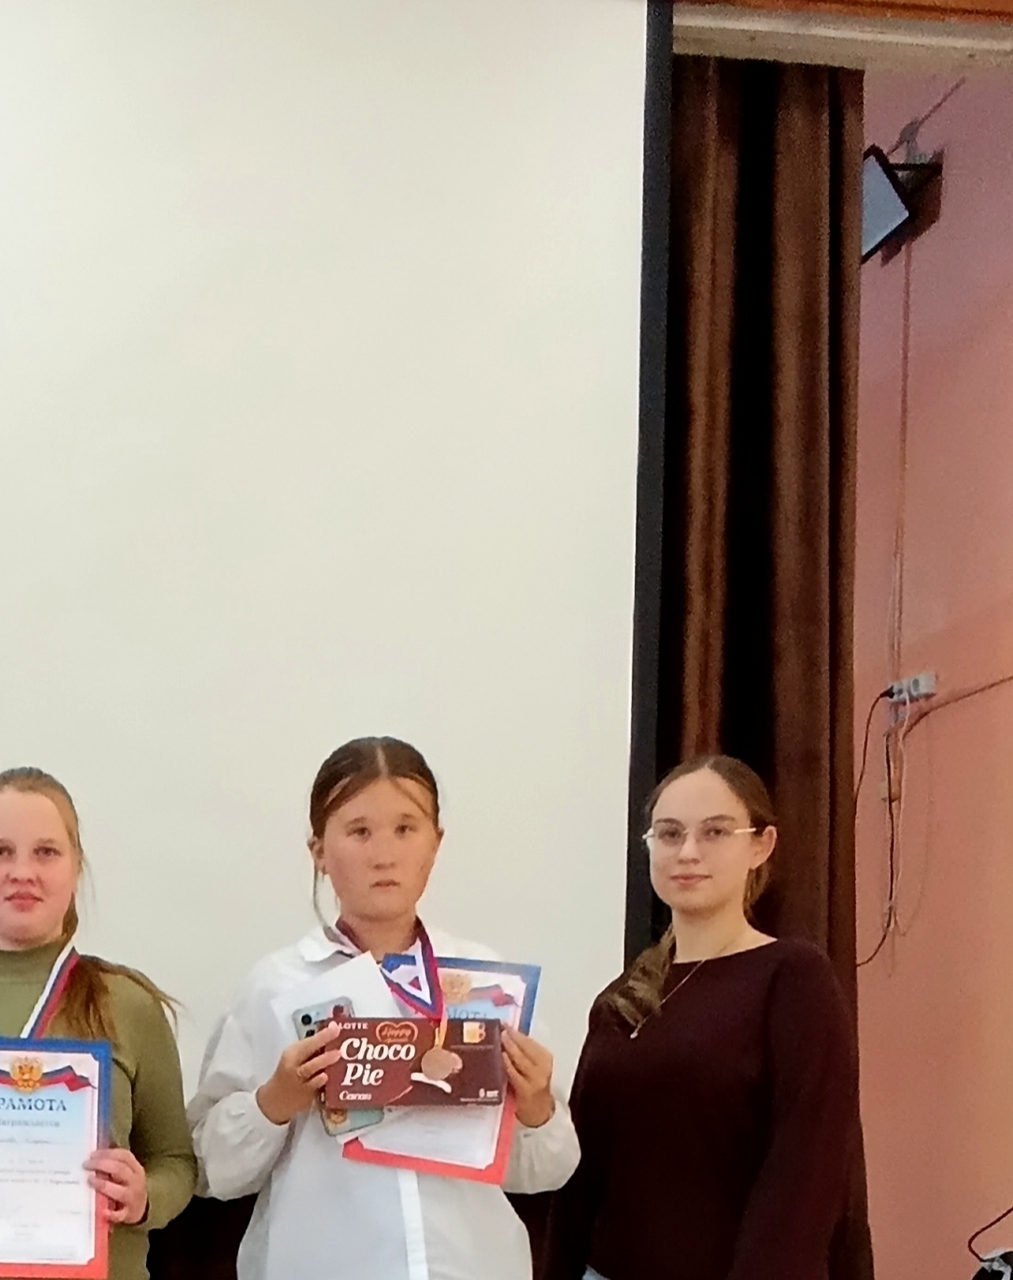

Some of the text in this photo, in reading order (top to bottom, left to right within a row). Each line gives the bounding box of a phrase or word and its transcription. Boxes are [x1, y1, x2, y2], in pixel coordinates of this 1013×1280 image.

[338, 1022, 369, 1030] LOTTE
[339, 1037, 416, 1061] Choco
[340, 1062, 385, 1086] Pie
